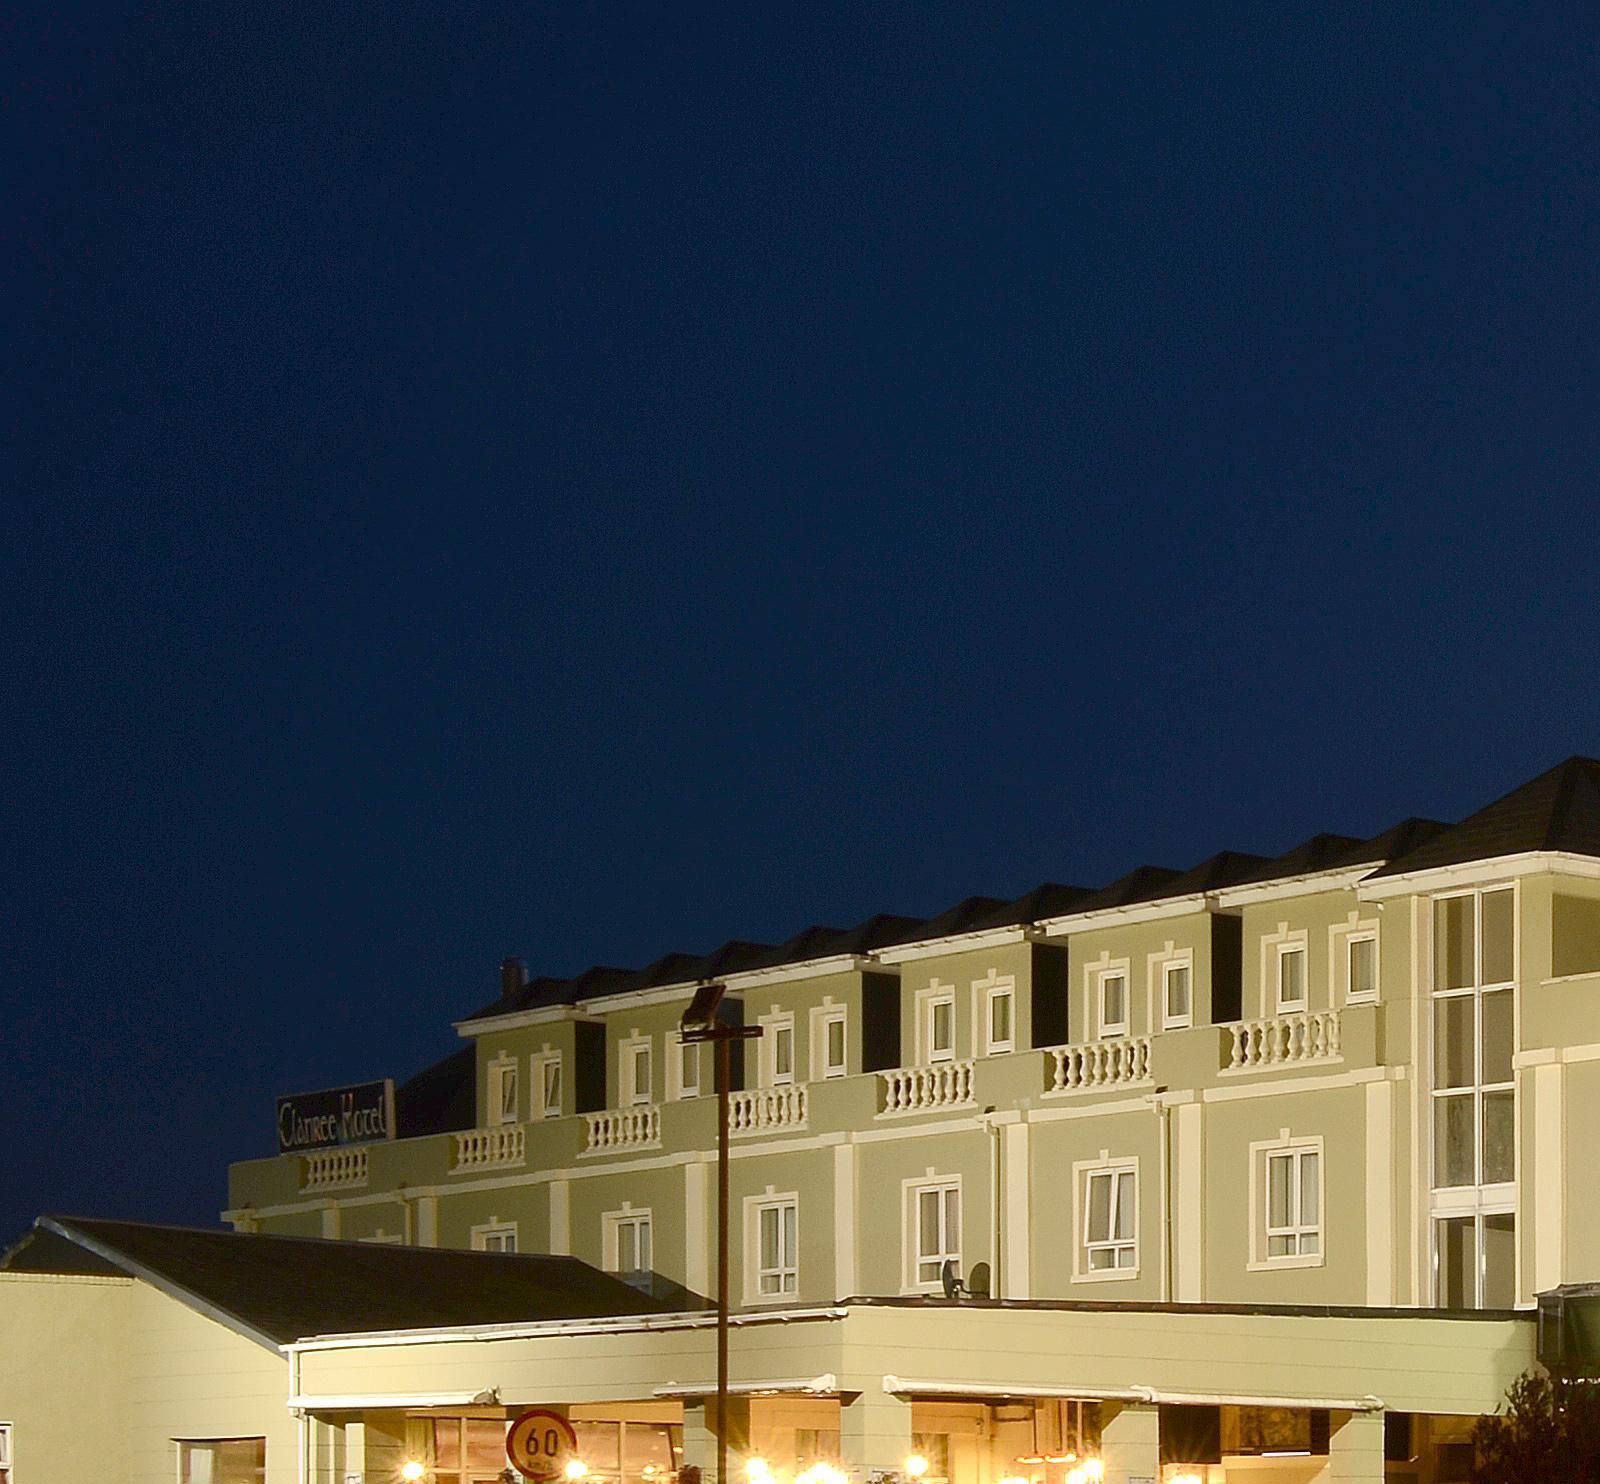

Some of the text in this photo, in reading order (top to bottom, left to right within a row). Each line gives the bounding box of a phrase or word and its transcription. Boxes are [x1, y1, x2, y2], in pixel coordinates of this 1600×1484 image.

[280, 1092, 387, 1147] Clanree Hotel
[526, 1428, 559, 1457] 60
